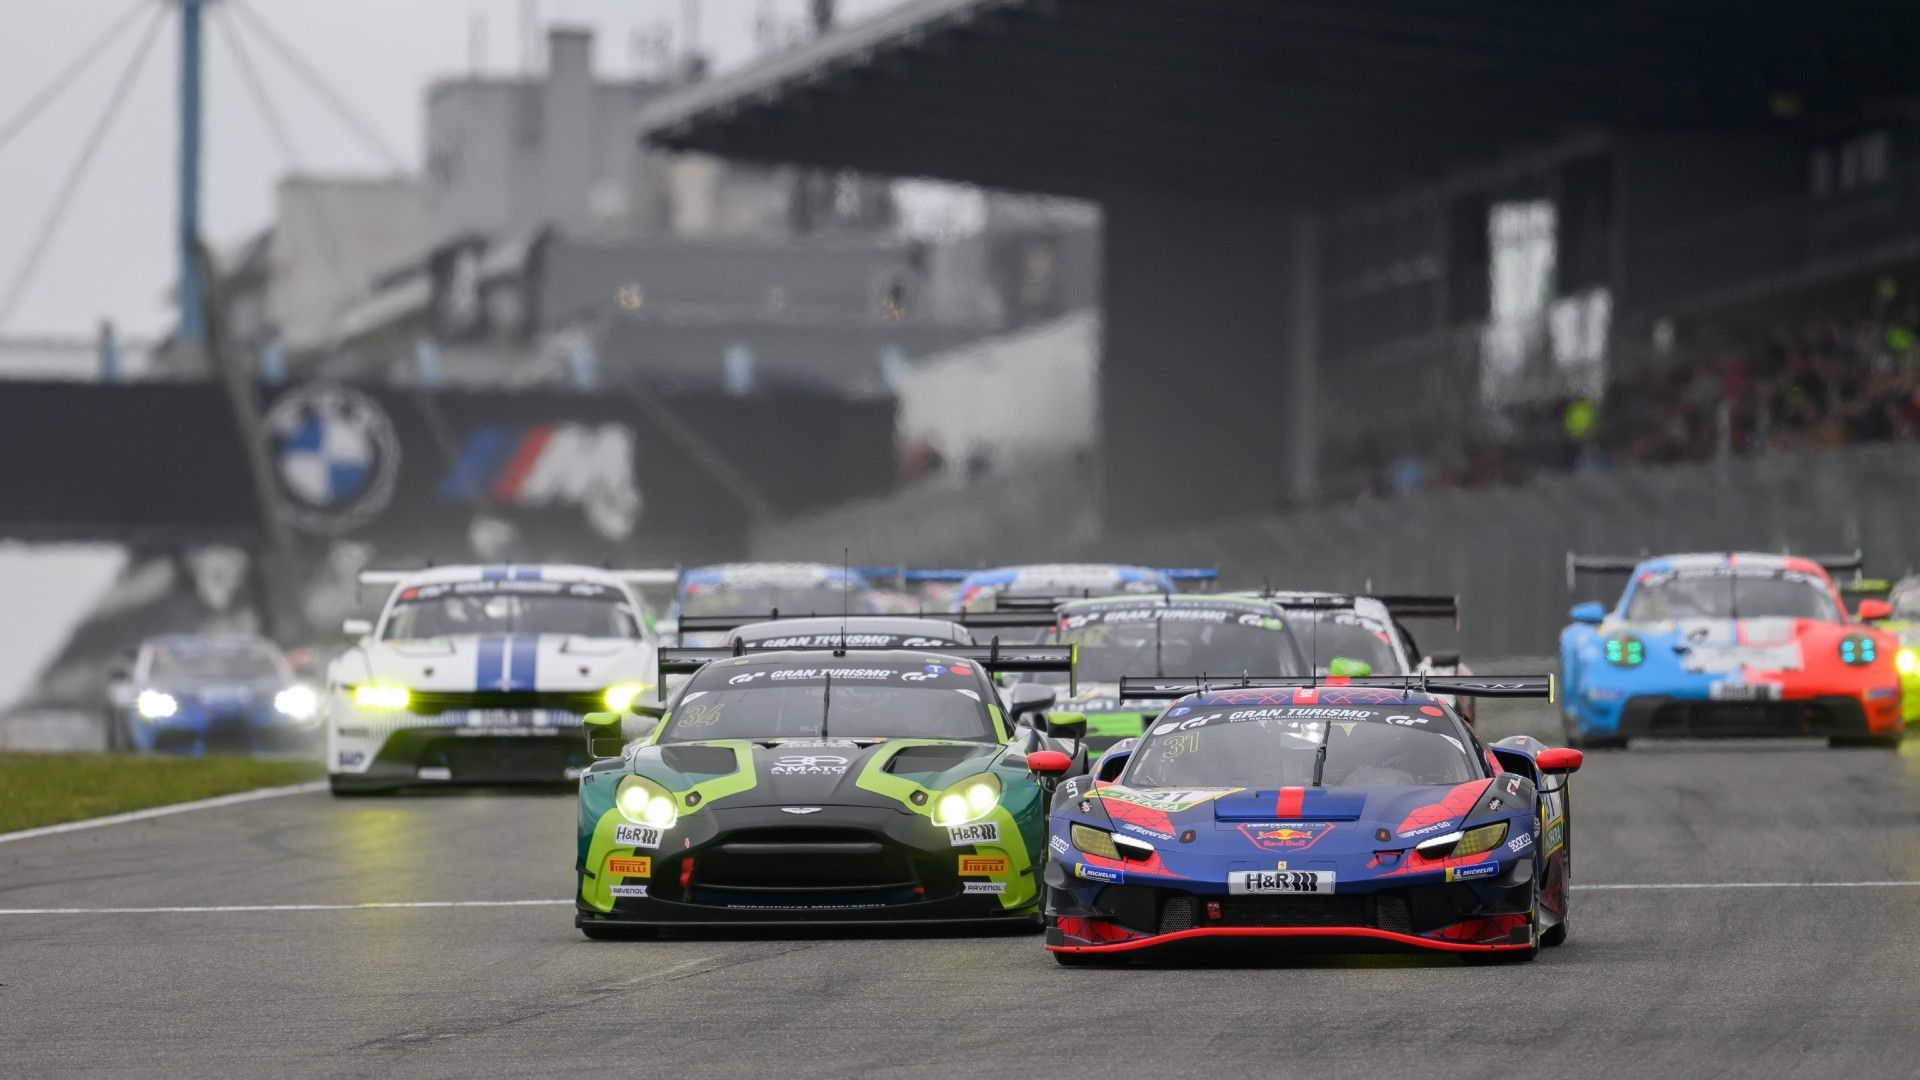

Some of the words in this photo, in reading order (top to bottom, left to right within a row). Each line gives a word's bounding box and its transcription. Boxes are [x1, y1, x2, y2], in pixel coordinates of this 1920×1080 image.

[762, 636, 811, 648] GRAN
[770, 669, 817, 678] GRAN
[819, 668, 892, 678] TURISMO
[1228, 709, 1284, 721] GRAN
[1285, 707, 1372, 718] TURISMO
[1163, 731, 1200, 760] 31
[616, 826, 642, 841] H&R
[950, 825, 980, 841] H&R
[1050, 835, 1070, 852] sparco
[1507, 832, 1532, 850] sparco
[609, 859, 647, 874] PIRELLI
[962, 859, 1005, 872] PIRELLI
[1462, 866, 1495, 877] MICHELIN
[1086, 869, 1117, 880] MICHELIN
